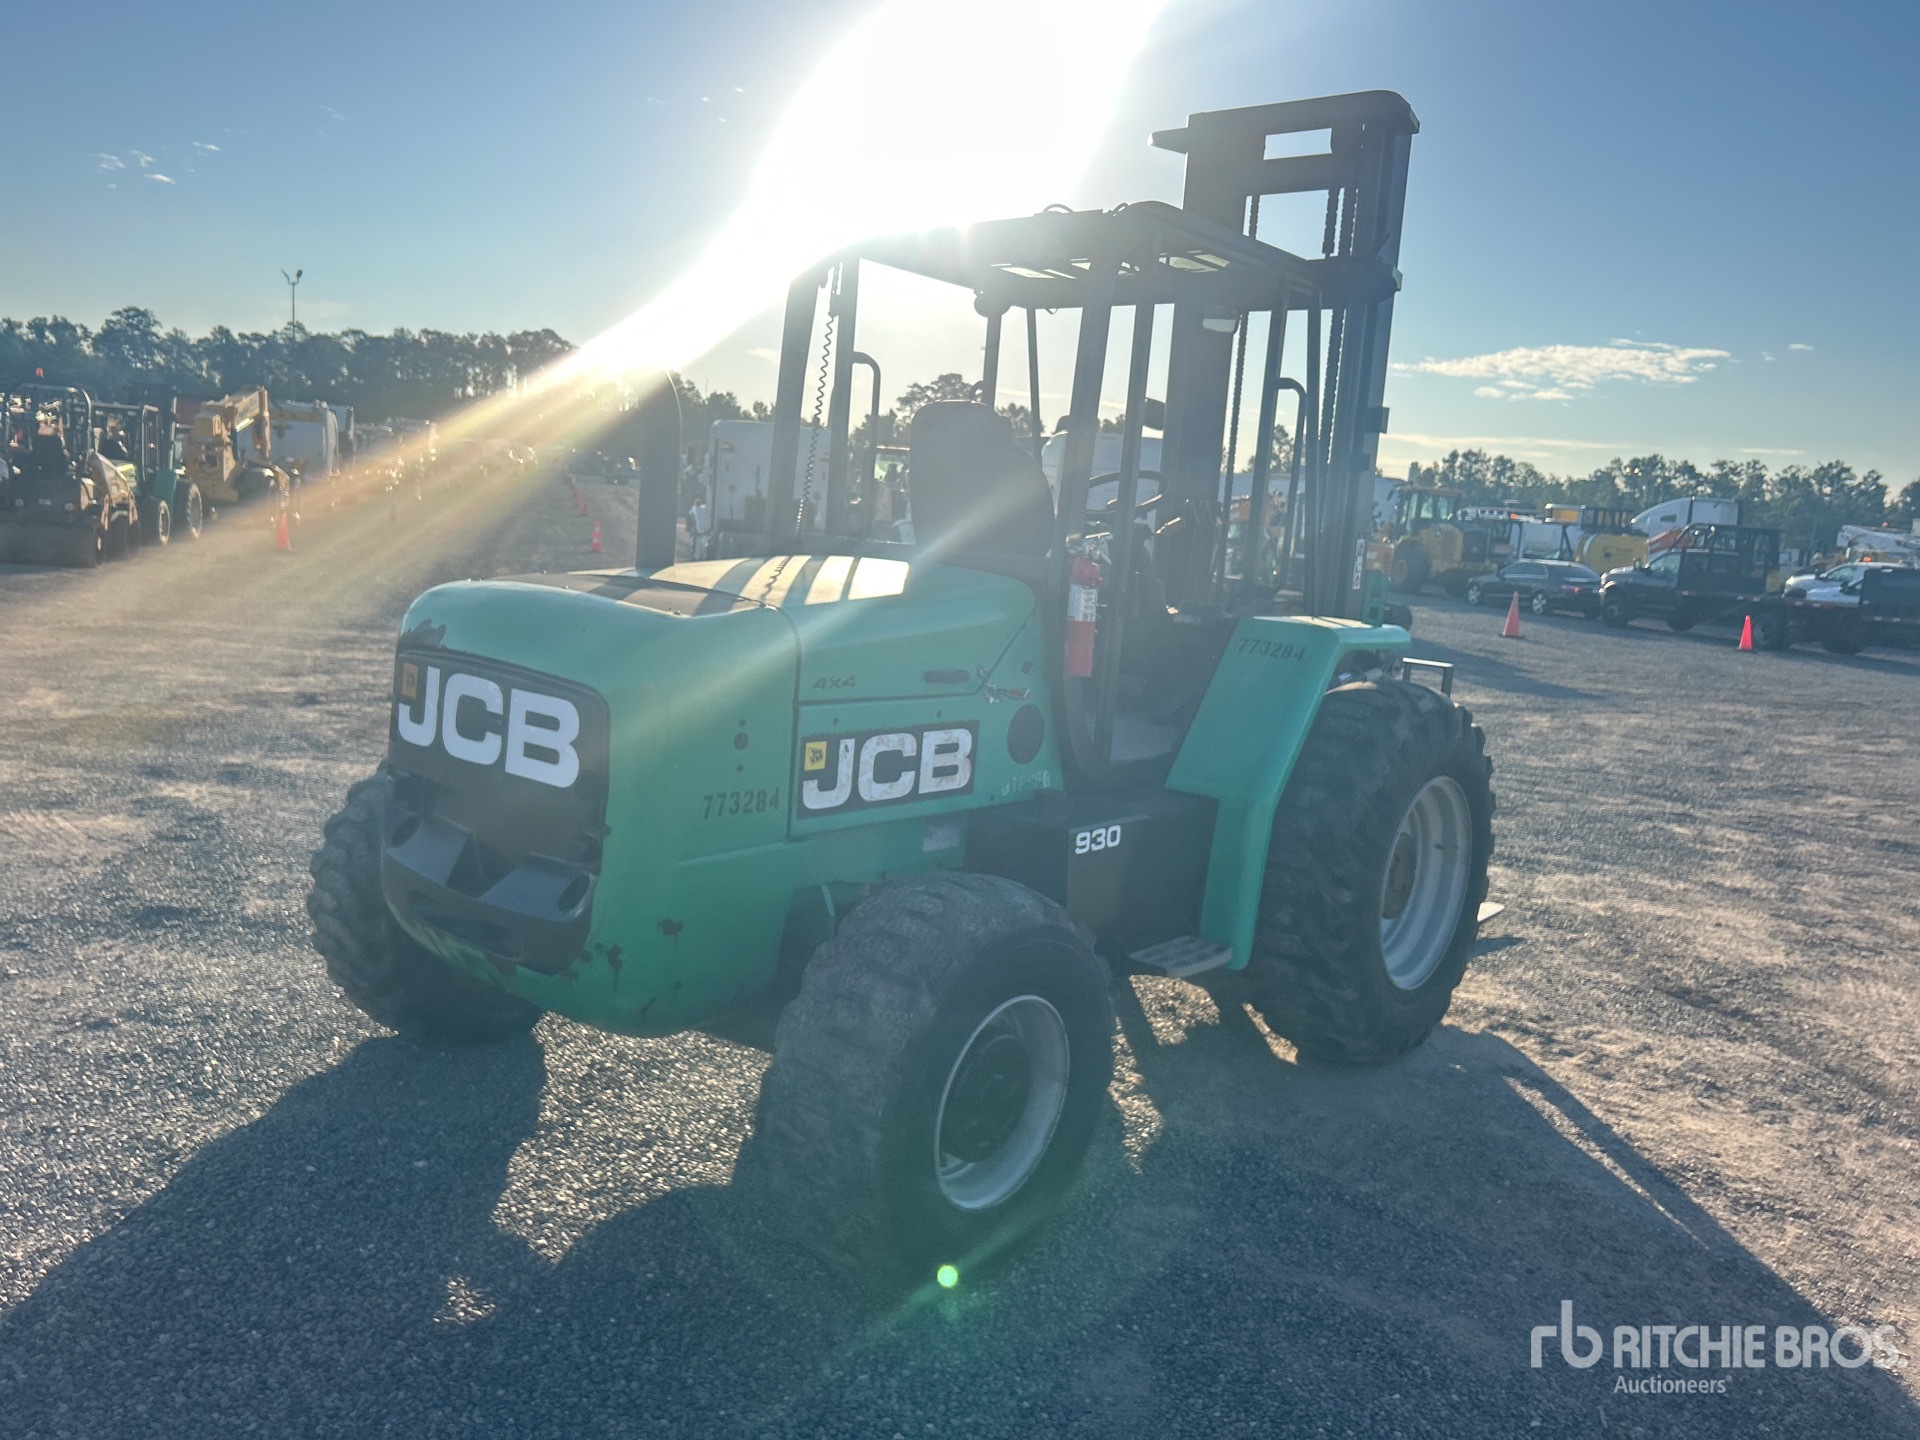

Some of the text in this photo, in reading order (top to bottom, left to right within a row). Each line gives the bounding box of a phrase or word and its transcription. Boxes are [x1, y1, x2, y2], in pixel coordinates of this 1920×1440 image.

[1238, 638, 1307, 661] 773284
[398, 666, 580, 788] JCB
[802, 728, 973, 810] JCB
[703, 790, 780, 819] 773284
[1075, 825, 1121, 855] 930
